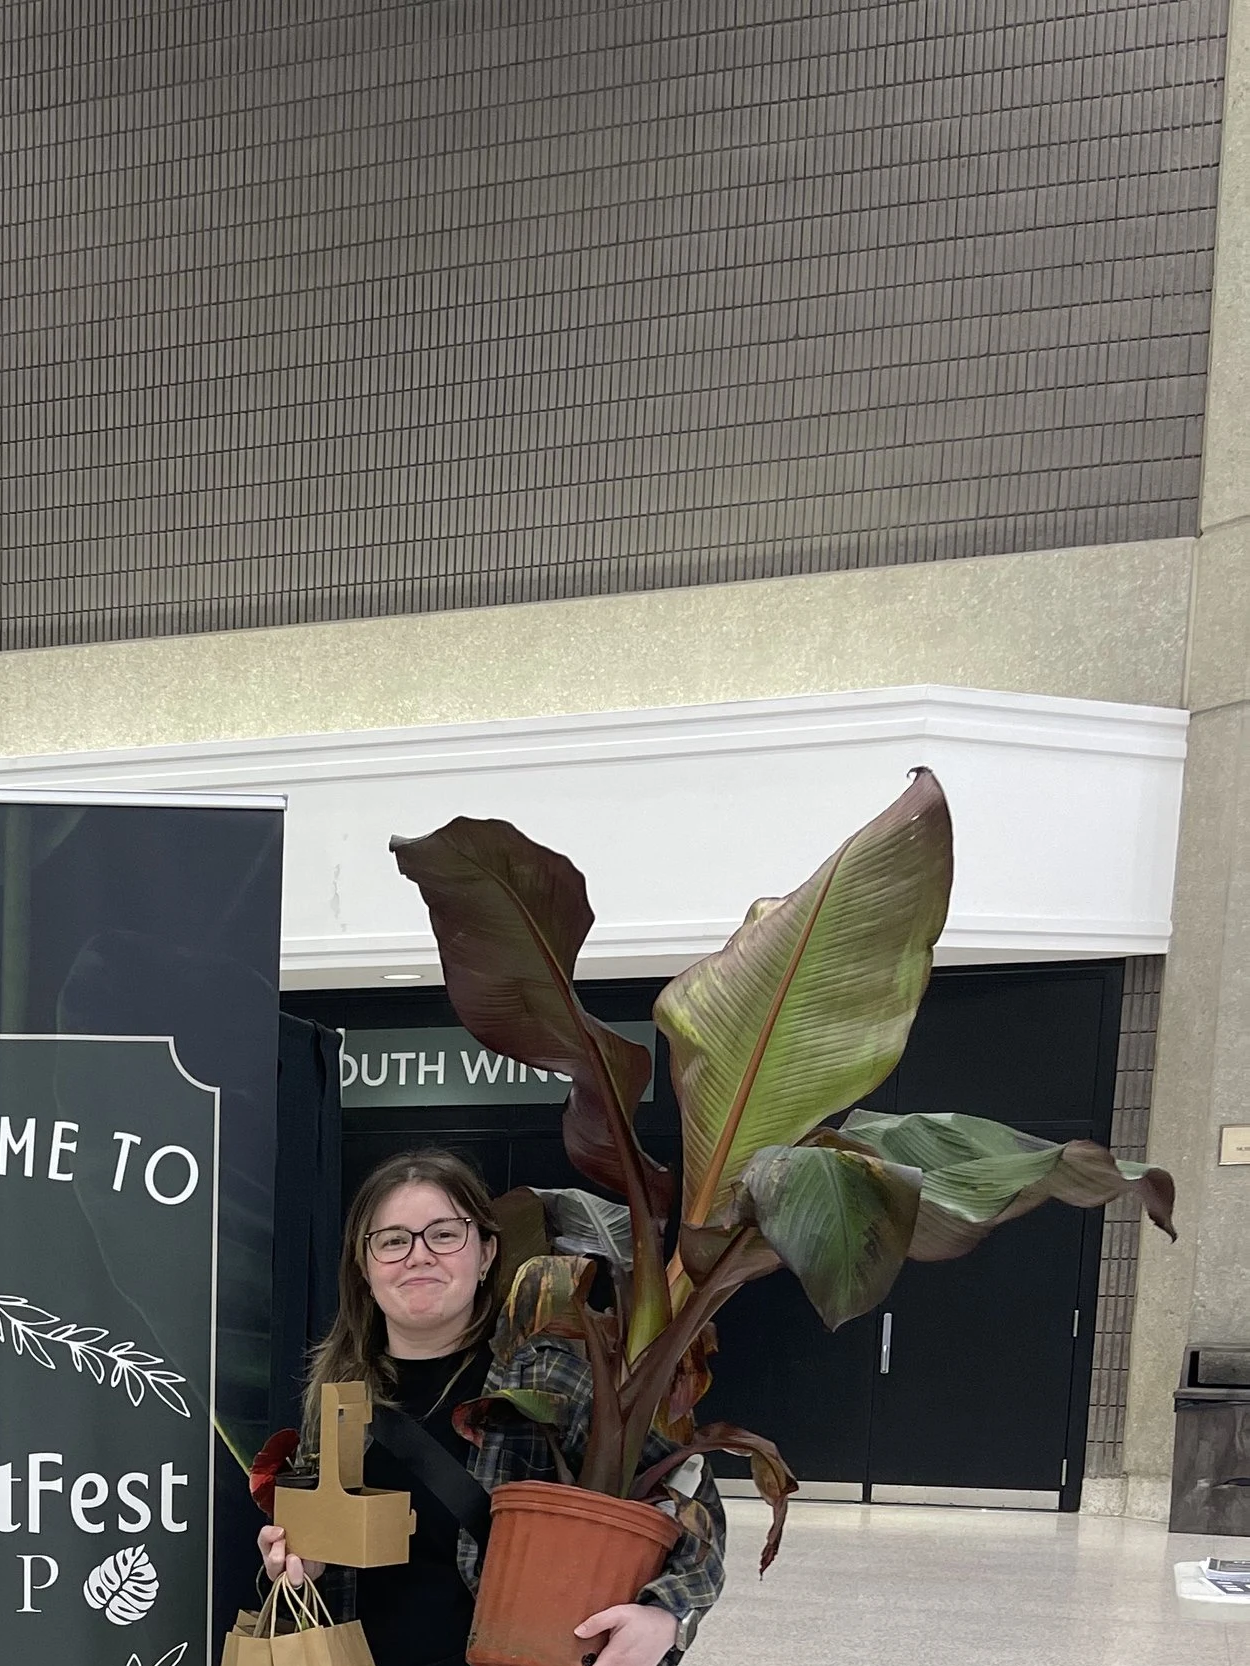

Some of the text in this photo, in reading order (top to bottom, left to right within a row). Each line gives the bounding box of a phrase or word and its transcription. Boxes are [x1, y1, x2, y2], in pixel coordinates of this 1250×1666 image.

[341, 1050, 573, 1087] OUTH WIN
[112, 1131, 200, 1206] TO
